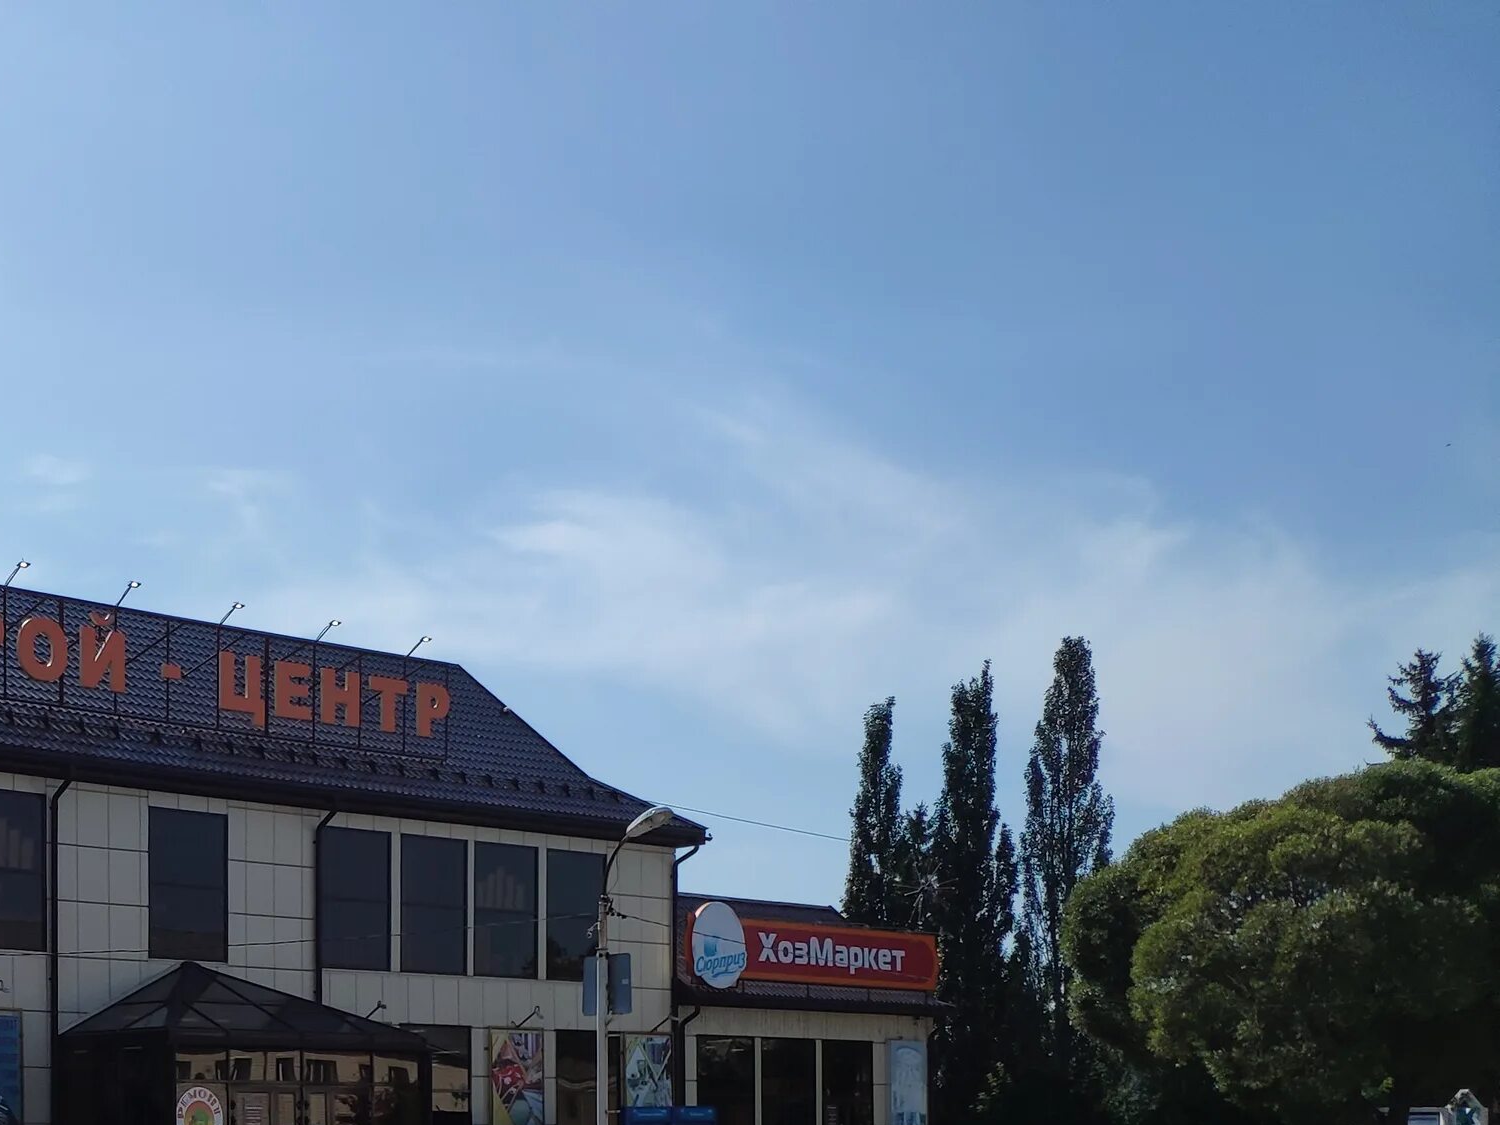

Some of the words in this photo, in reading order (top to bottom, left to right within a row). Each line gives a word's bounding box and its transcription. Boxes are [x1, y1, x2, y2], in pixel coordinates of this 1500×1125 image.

[218, 651, 451, 738] ЦЕНТР
[695, 951, 746, 974] Сюрприз
[757, 932, 906, 974] ХозМаркет
